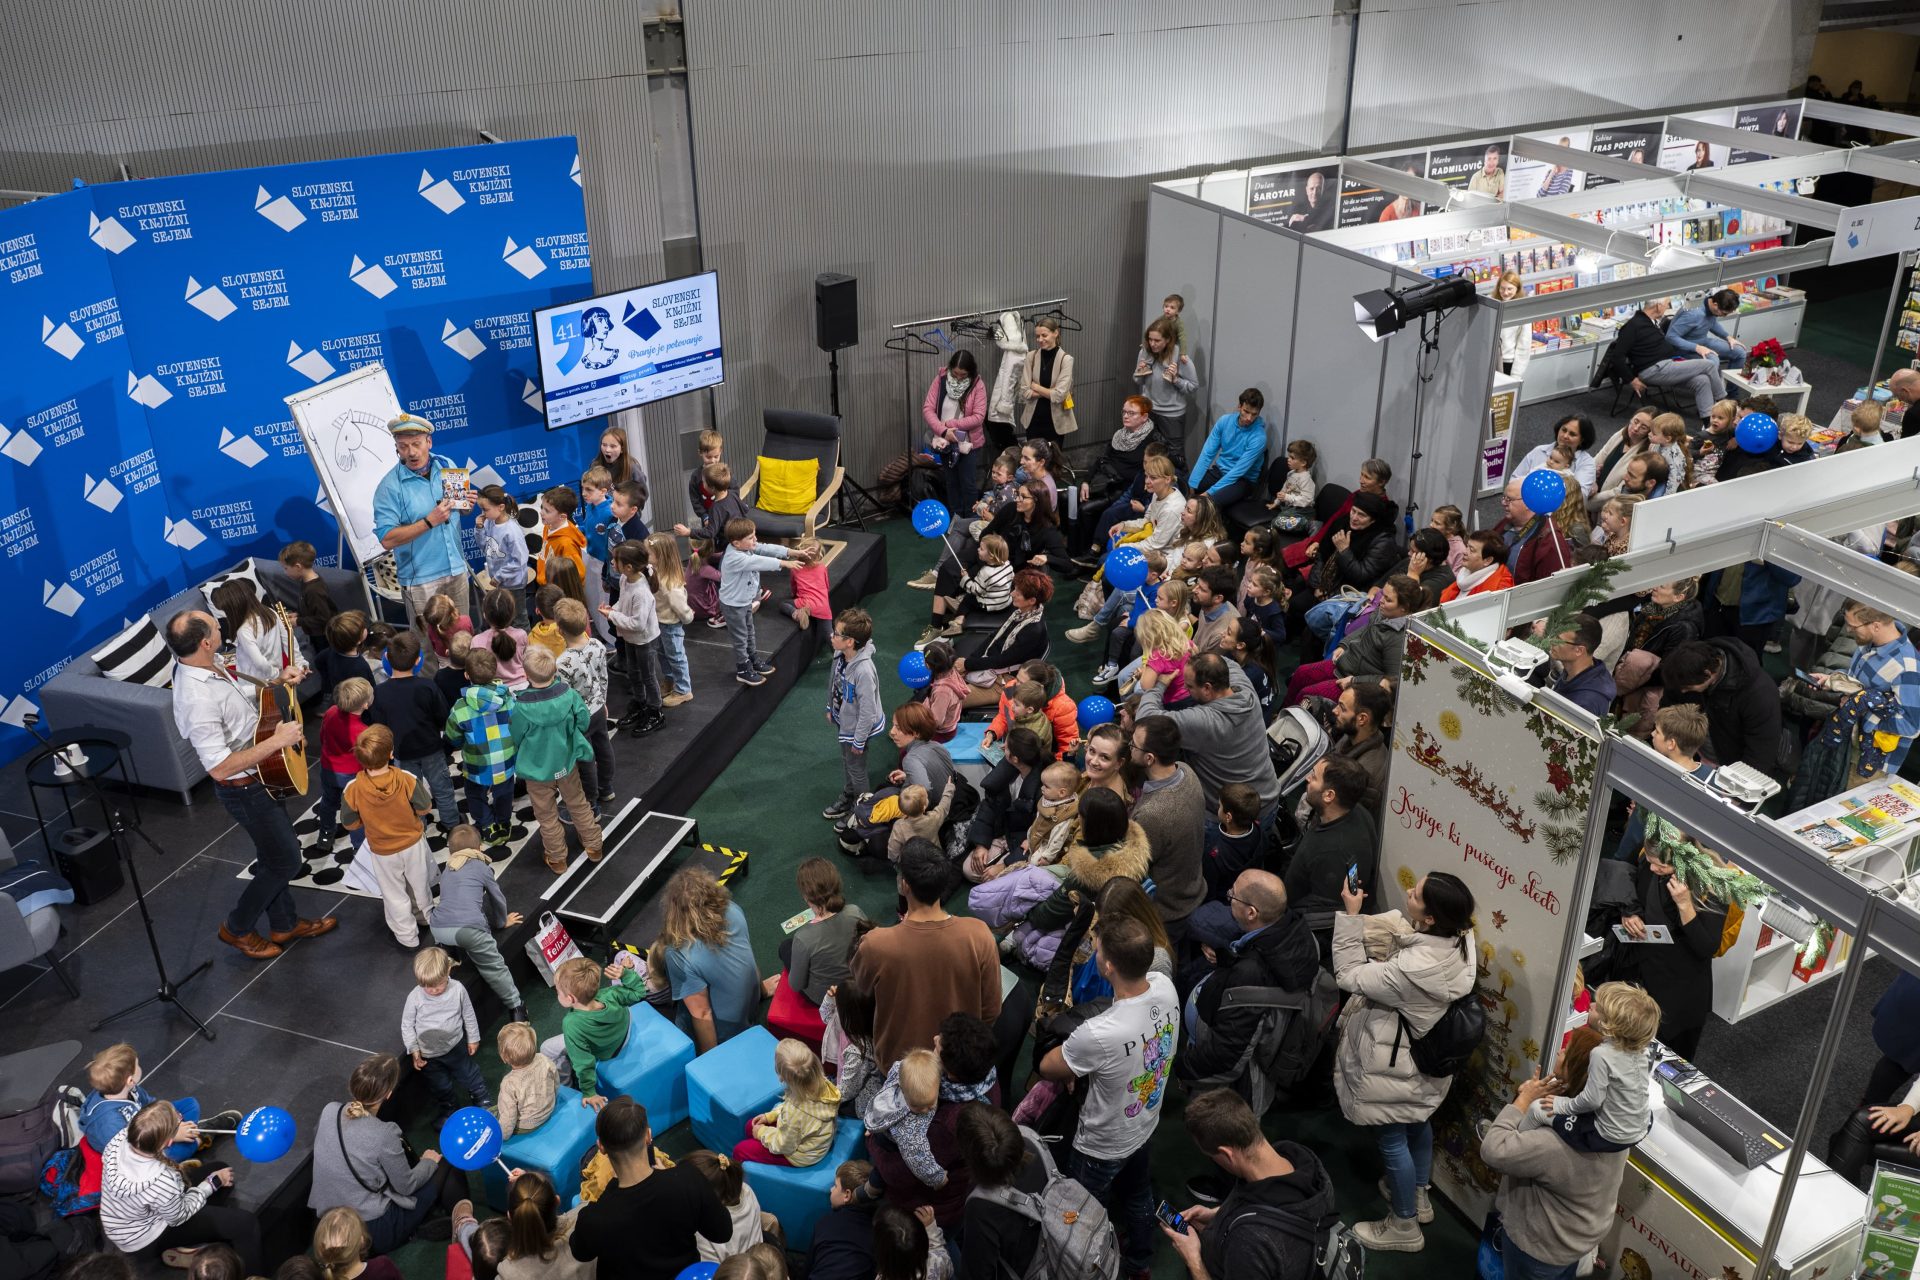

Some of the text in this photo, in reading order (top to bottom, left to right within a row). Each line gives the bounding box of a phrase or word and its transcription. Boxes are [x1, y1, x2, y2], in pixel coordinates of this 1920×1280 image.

[1593, 143, 1612, 152] FRAS
[453, 165, 511, 181] SLOVENSKI
[292, 181, 354, 197] SLOVENSKI
[470, 178, 513, 193] KNJIŽNI
[310, 195, 357, 210] KNJIŽNI
[480, 191, 514, 205] SEJEM
[1253, 188, 1296, 202] ŠAROTAR
[119, 200, 186, 218] SLOVENSKI
[322, 209, 359, 222] SEJEM
[139, 213, 189, 231] KNJIŽNI
[153, 228, 192, 243] SEJEM
[0, 248, 40, 271] KNJIŽNI
[384, 250, 443, 266] SLOVENSKI
[11, 263, 43, 284] SEJEM
[222, 269, 285, 287] SLOVENSKI
[401, 262, 445, 278] KNJIŽNI
[240, 282, 288, 298] KNJIŽNI
[412, 275, 447, 289] SEJEM
[253, 296, 290, 311] SEJEM
[652, 289, 701, 309] SLOVENSKI
[69, 297, 118, 323] SLOVENSKI
[665, 301, 702, 319] KNJIŽNI
[85, 311, 122, 333] KNJIŽNI
[474, 313, 530, 329] SLOVENSKI
[673, 314, 703, 329] SEJEM
[95, 324, 124, 344] SEJEM
[490, 325, 531, 340] KNJIŽNI
[556, 323, 581, 341] 41.
[322, 333, 381, 351] SLOVENSKI
[500, 337, 532, 351] SEJEM
[338, 346, 383, 361] KNJIŽNI
[628, 346, 656, 360] Branje
[157, 357, 220, 375] SLOVENSKI
[176, 370, 223, 387] KNJIŽNI
[188, 383, 226, 398] SEJEM
[409, 393, 465, 411] SLOVENSKI
[27, 399, 78, 429] SLOVENSKI
[424, 406, 467, 420] KNJIŽNI
[44, 412, 82, 437] KNJIŽNI
[435, 417, 469, 431] SEJEM
[54, 426, 85, 447] SEJEM
[109, 449, 155, 477] SLOVENSKI
[494, 448, 547, 466] SLOVENSKI
[124, 463, 158, 485] KNJIŽNI
[509, 459, 549, 475] KNJIŽNI
[134, 474, 161, 494] SEJEM
[518, 471, 550, 484] SEJEM
[192, 501, 253, 520] SLOVENSKI
[210, 513, 255, 529] KNJIŽNI
[222, 525, 258, 539] SEJEM
[7, 534, 39, 558] SEJEM
[70, 549, 118, 581] SLOVENSKI
[85, 561, 121, 588] KNJIŽNI
[96, 574, 124, 596] SEJEM
[1390, 786, 1561, 916] Knjige, ki puščajo sledi
